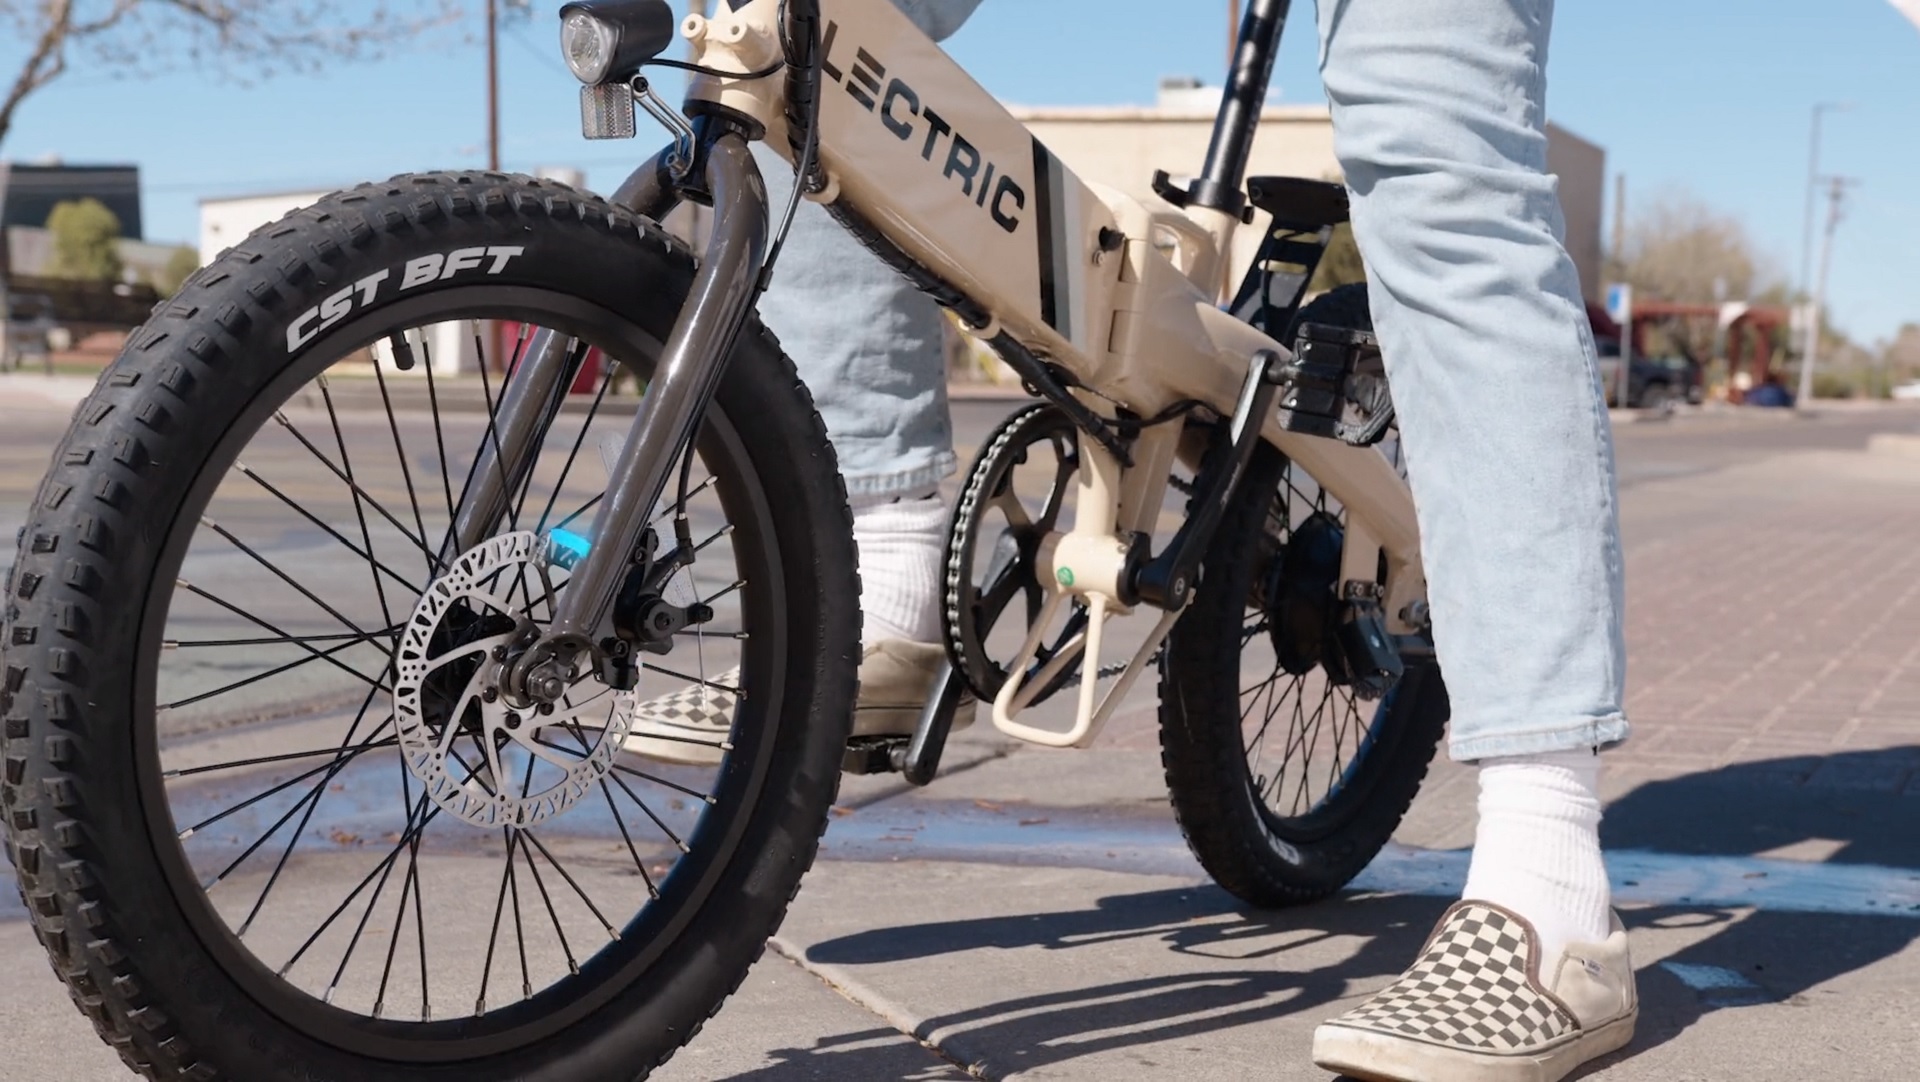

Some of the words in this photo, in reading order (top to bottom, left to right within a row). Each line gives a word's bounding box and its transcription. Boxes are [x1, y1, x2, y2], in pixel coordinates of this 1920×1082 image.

[820, 19, 1025, 233] LECTRIC
[286, 268, 389, 353] CST
[399, 246, 525, 291] BFT
